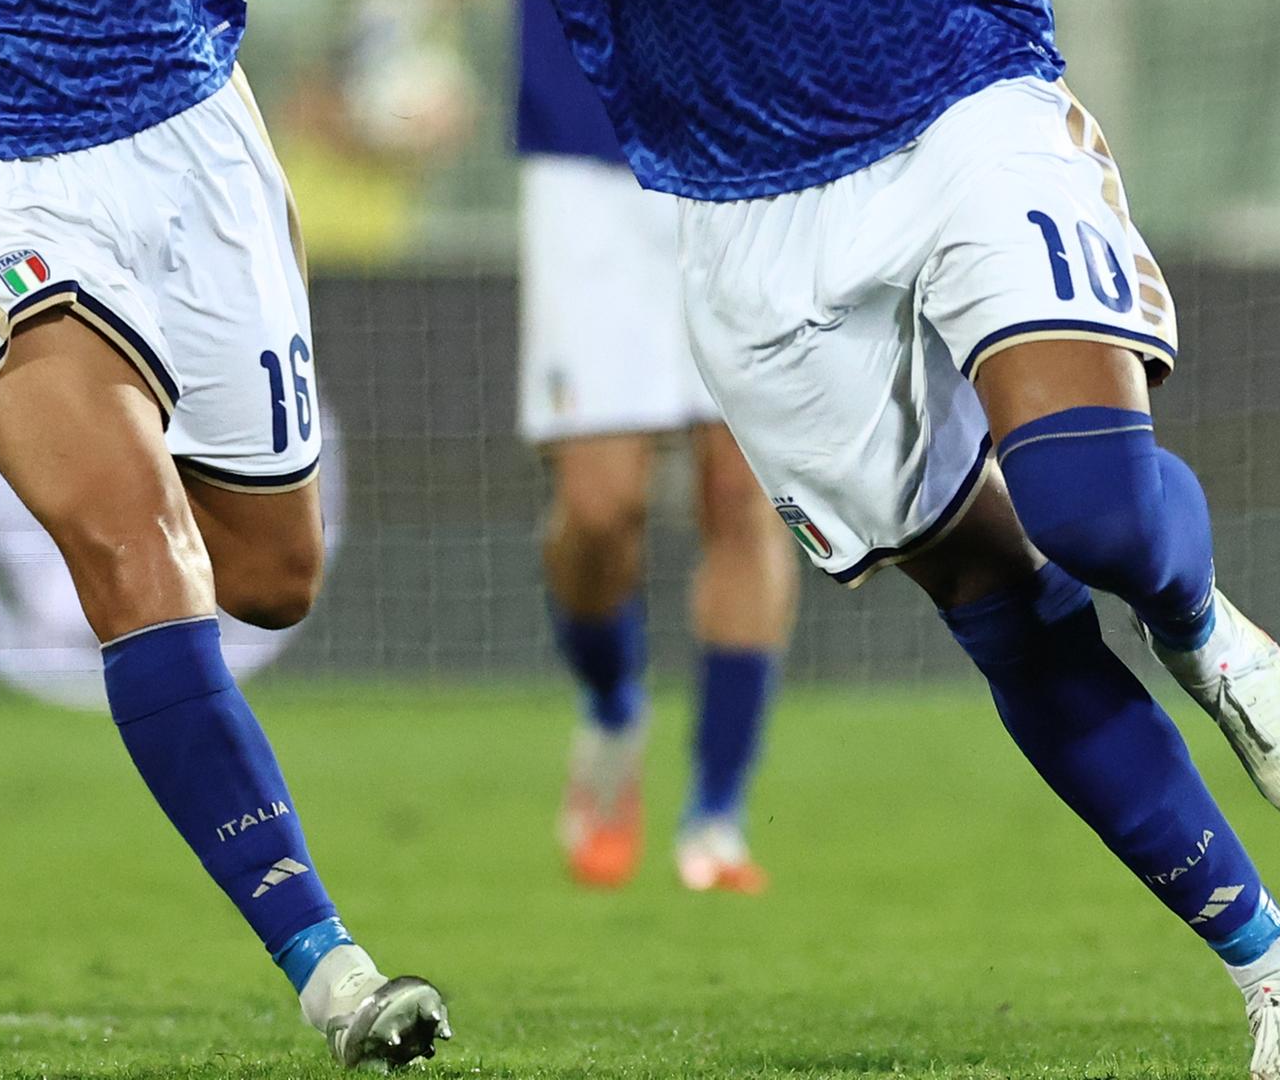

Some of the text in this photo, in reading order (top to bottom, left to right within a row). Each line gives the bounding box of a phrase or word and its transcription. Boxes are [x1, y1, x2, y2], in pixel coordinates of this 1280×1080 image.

[1027, 210, 1133, 314] 10
[260, 332, 311, 454] 16
[216, 800, 290, 842] ITALIA
[1145, 829, 1215, 885] ITALIA
